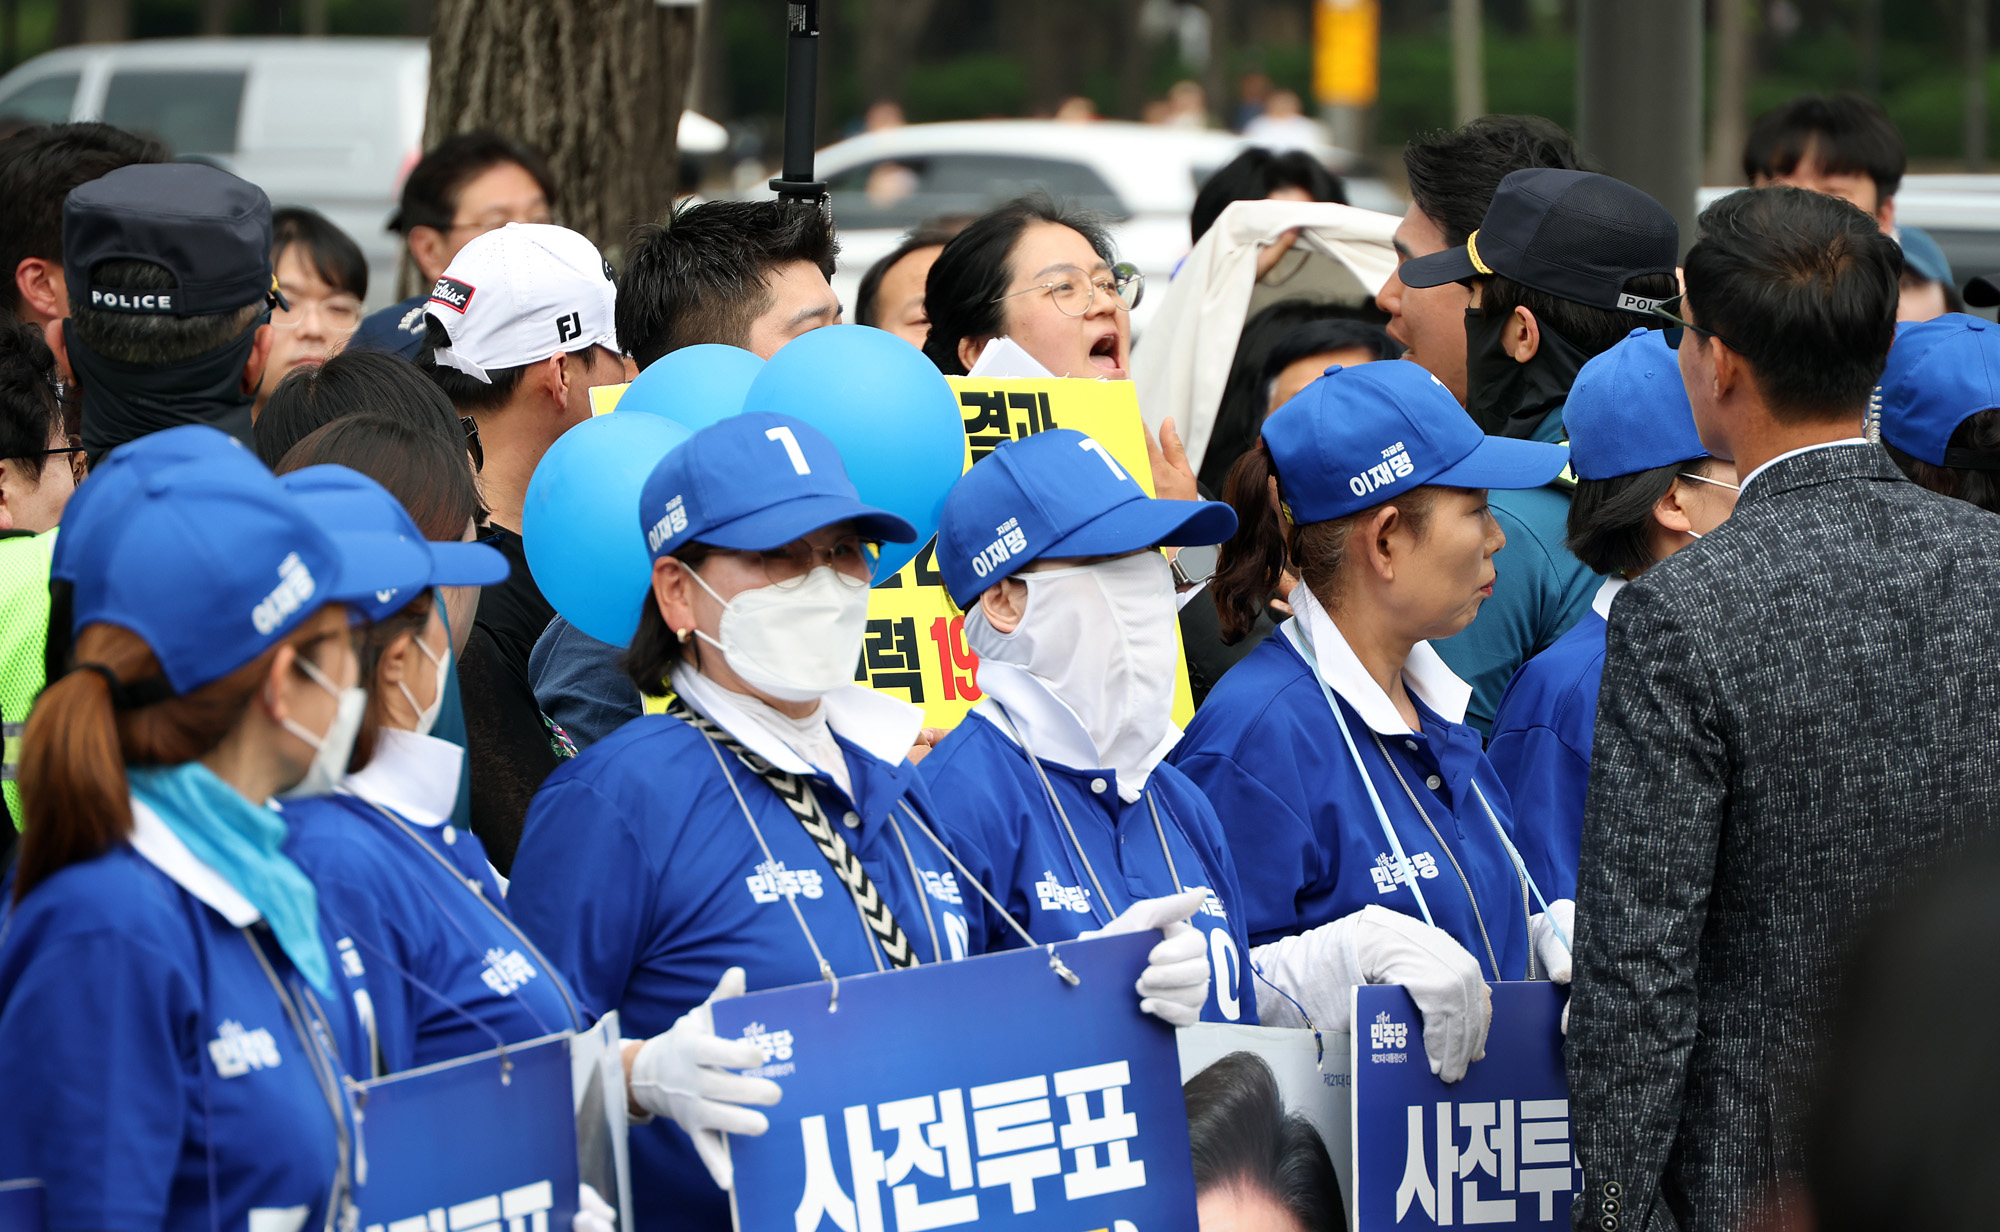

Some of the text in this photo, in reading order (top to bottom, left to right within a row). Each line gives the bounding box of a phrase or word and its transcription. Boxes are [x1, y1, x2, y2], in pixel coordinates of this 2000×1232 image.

[92, 290, 171, 309] POLICE
[1625, 296, 1662, 312] POL
[556, 311, 582, 343] FJ
[765, 426, 811, 475] 1
[1078, 438, 1128, 480] 1
[1380, 441, 1405, 459] 지금은
[1349, 450, 1414, 496] 이재명
[648, 504, 688, 552] 이재명
[996, 517, 1018, 536] 지금은
[972, 526, 1027, 578] 이재명
[745, 869, 823, 904] 민주당
[1370, 851, 1439, 894] 민주당
[1370, 1022, 1408, 1049] 민주당
[794, 1060, 1146, 1232] 사전투표
[1396, 1099, 1586, 1226] 사전투
